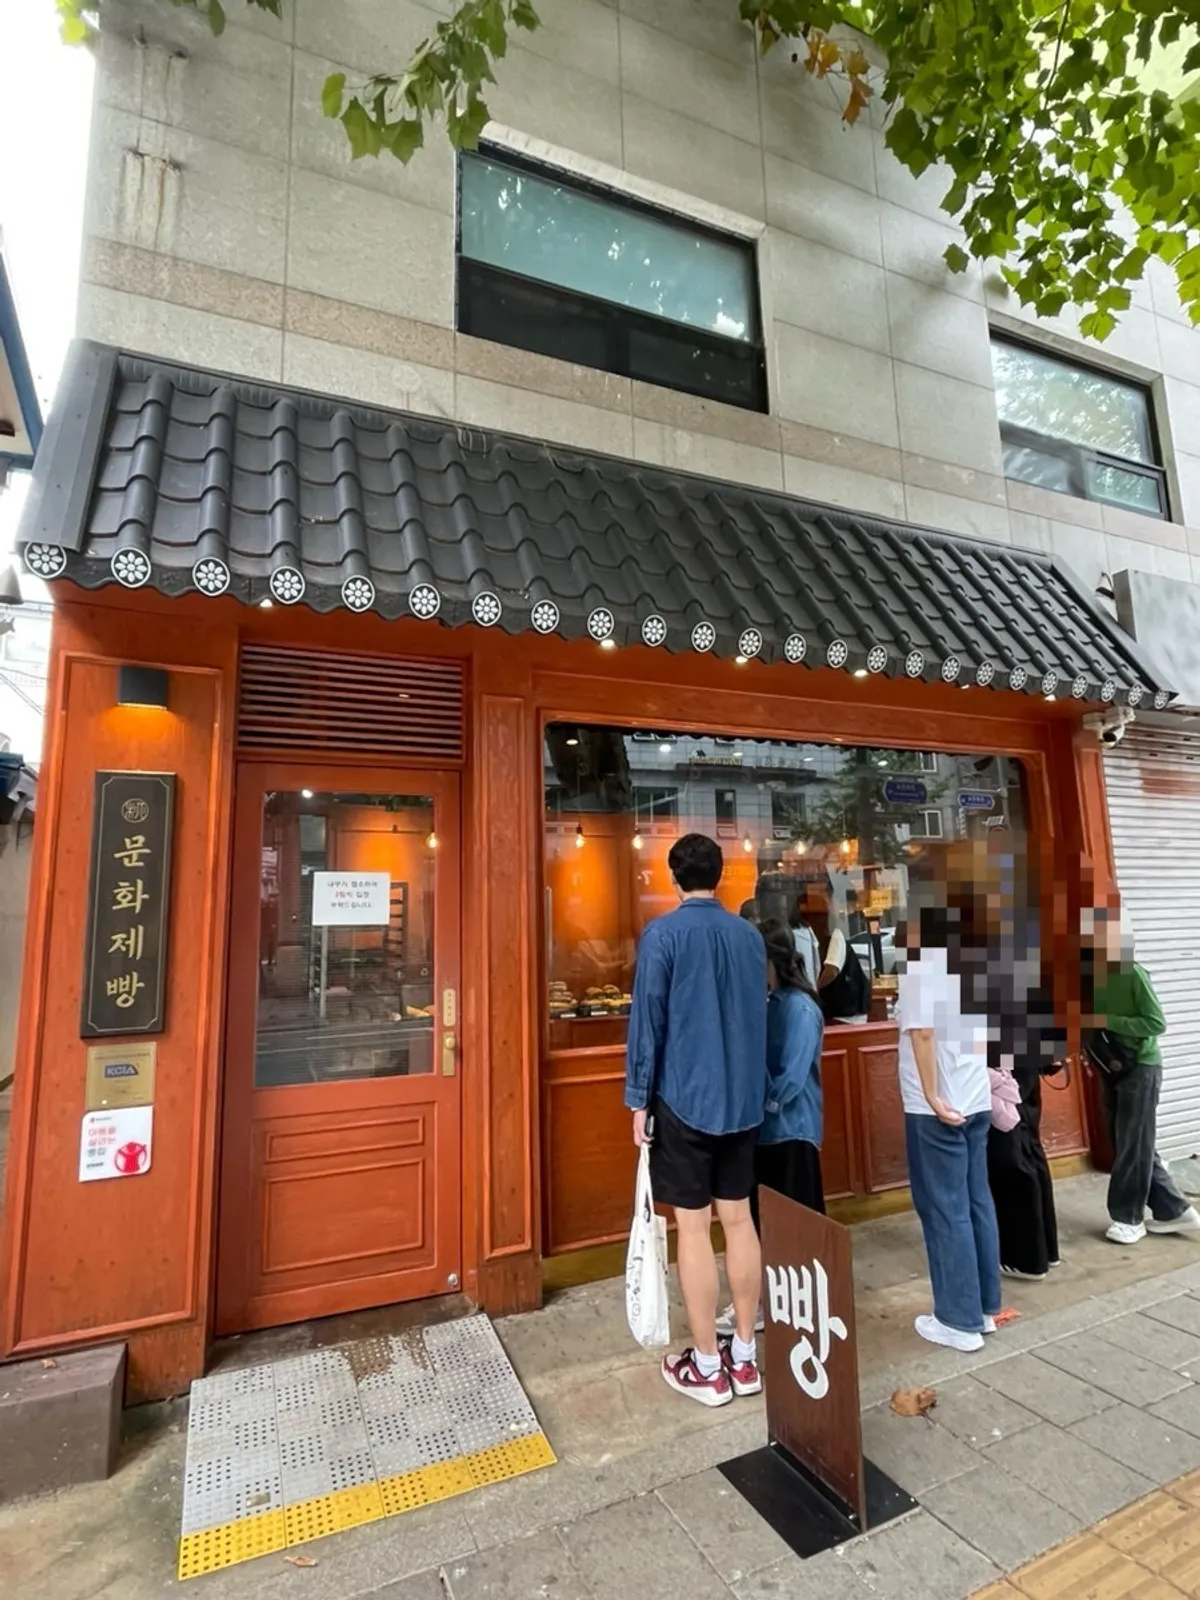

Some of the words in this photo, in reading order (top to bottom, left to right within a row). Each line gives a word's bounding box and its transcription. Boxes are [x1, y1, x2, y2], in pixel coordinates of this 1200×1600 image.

[106, 836, 152, 1008] 문화제빵
[106, 1065, 136, 1076] KCIA
[765, 1258, 848, 1399] 빵
